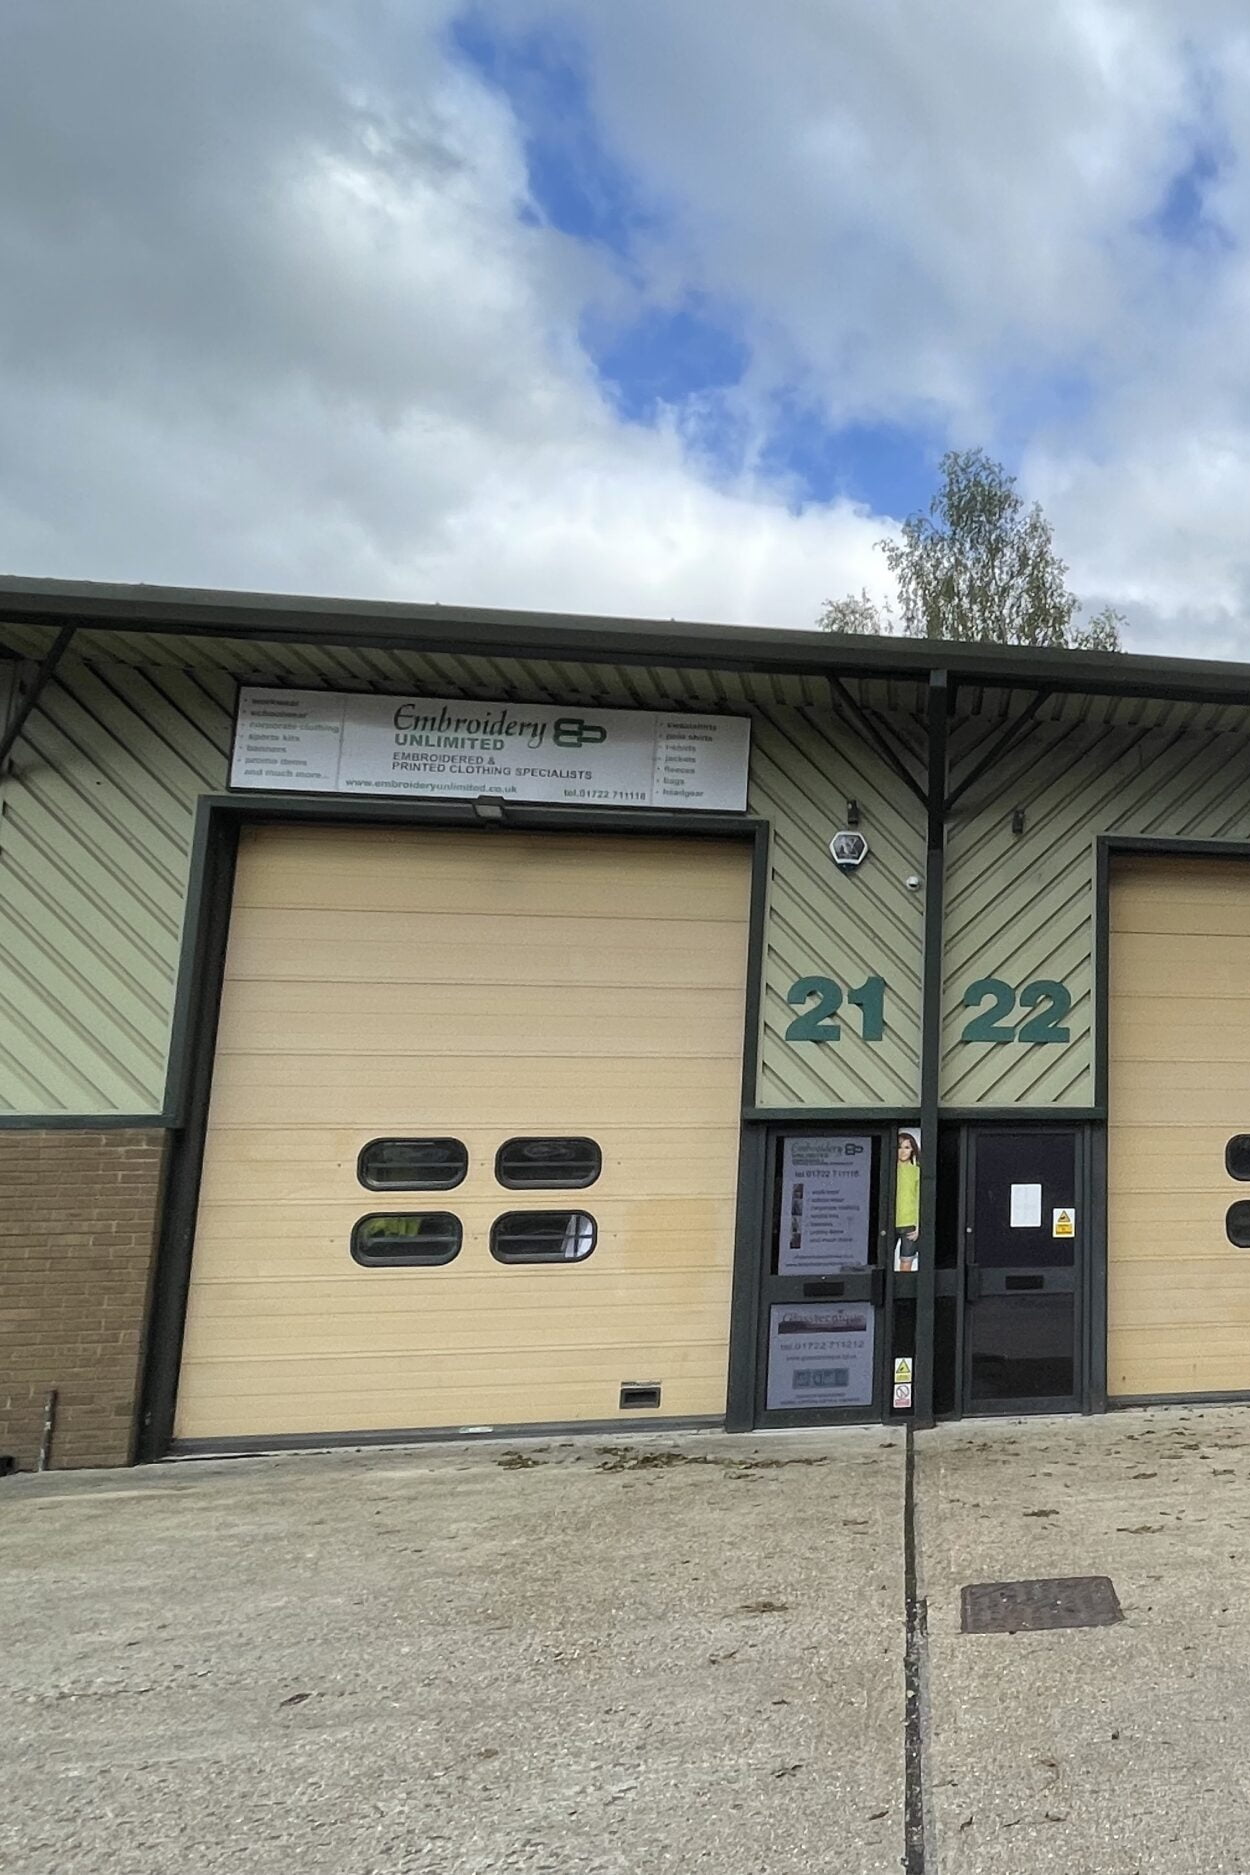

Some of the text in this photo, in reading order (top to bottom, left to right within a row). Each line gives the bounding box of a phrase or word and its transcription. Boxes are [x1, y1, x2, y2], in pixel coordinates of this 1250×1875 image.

[393, 703, 548, 750] Embroidery
[394, 733, 505, 751] UNLIMITED
[393, 752, 496, 766] EMBROIDERED &
[391, 761, 593, 780] PRINTED CLOTHING SPECIALISTS
[345, 777, 518, 794] www.embroideryunlimited.co.uk
[785, 976, 885, 1042] 21
[961, 978, 1072, 1043] 22
